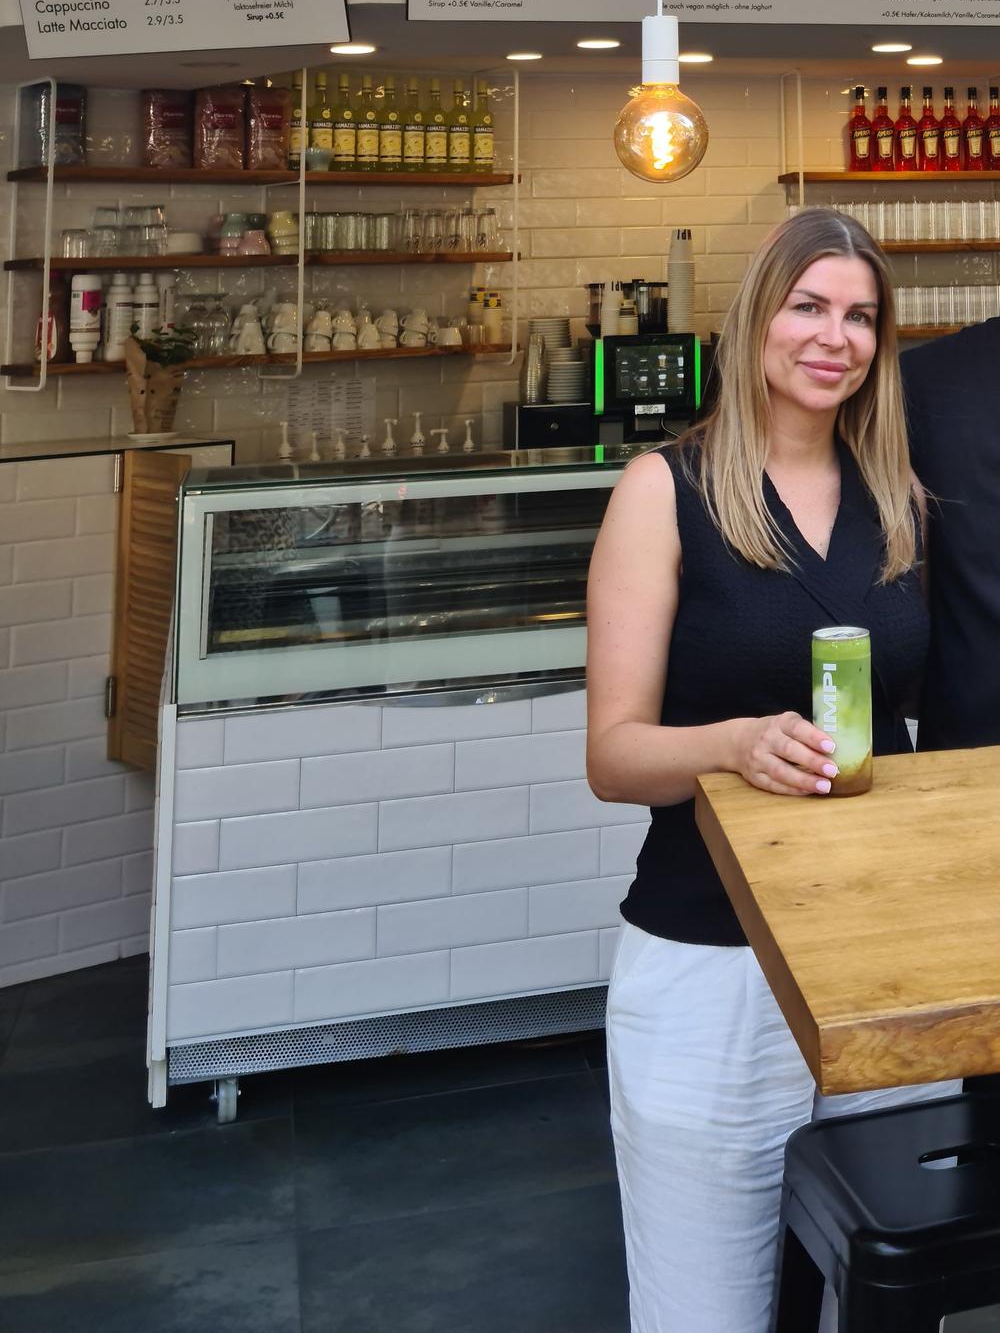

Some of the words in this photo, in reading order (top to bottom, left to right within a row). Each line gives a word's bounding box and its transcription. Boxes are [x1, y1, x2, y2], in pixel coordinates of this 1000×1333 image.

[35, 0, 110, 16] Cappuccino
[38, 20, 65, 34] Latte
[69, 18, 127, 32] Macciato
[147, 15, 184, 26] 2.9/3.5
[823, 664, 836, 732] IMPI
